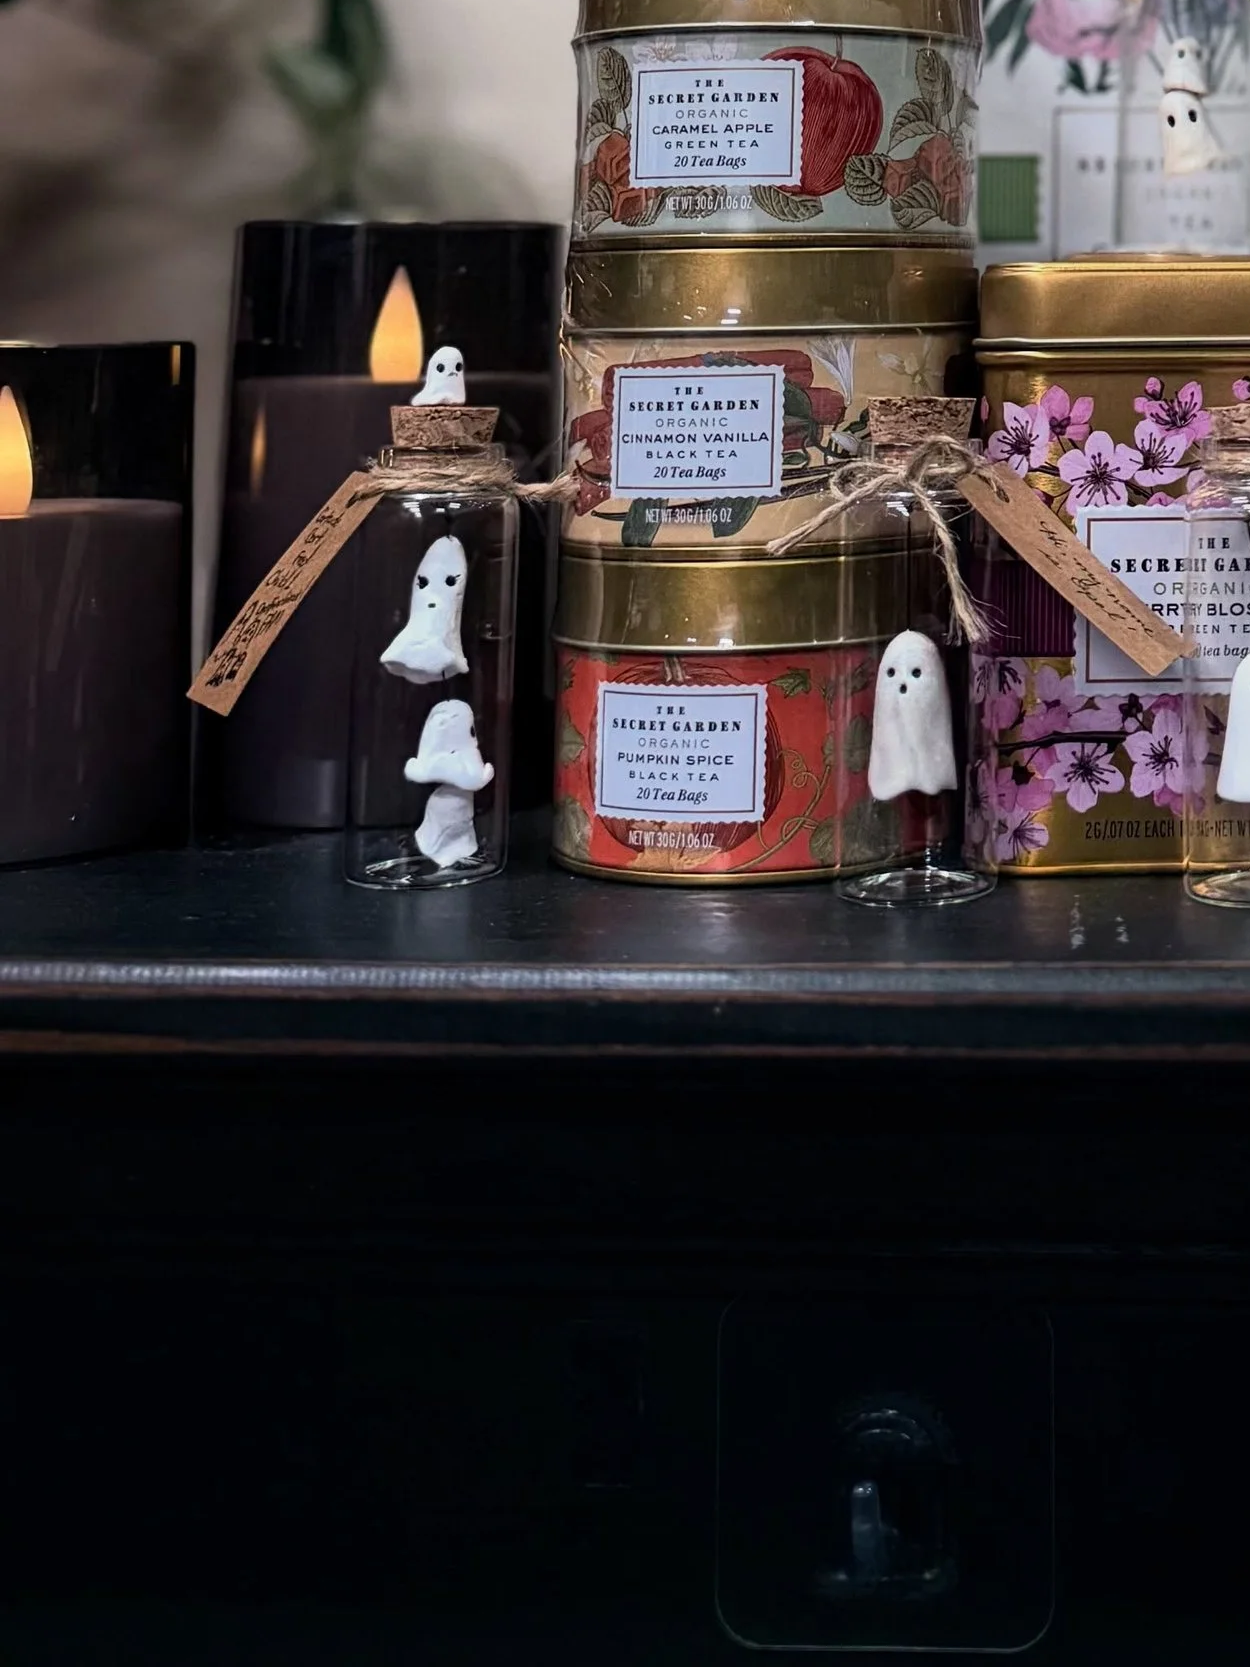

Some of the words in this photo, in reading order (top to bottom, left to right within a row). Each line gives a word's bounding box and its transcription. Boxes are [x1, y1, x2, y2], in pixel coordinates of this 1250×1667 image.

[695, 79, 725, 88] THE
[648, 93, 705, 105] SECRET
[711, 92, 779, 104] GARDEN
[675, 108, 749, 119] ORGANIC
[652, 124, 719, 135] CARAMEL
[723, 123, 774, 134] APPLE
[664, 139, 719, 150] GREEN
[727, 139, 760, 149] TEA
[674, 155, 689, 168] 20
[690, 155, 714, 168] Tea
[716, 155, 748, 170] Bags
[665, 196, 681, 211] NET
[681, 196, 693, 211] WT
[740, 194, 753, 210] OZ
[674, 387, 705, 396] THE
[629, 401, 685, 412] SECRET
[691, 399, 760, 411] GARDEN
[655, 417, 729, 428] ORGANIC
[622, 433, 697, 444] CINNAMON
[703, 432, 769, 443] VANILLA
[646, 450, 697, 459] BLACK
[706, 449, 738, 459] TEA
[653, 466, 669, 479] 20
[670, 466, 693, 479] Tea
[696, 466, 727, 481] Bags
[645, 508, 661, 523] NET
[661, 507, 673, 523] WT
[719, 507, 732, 523] OZ
[1198, 537, 1230, 549] THE
[656, 706, 686, 715] THE
[612, 718, 667, 732] SECRET
[672, 720, 742, 732] GARDEN
[638, 737, 711, 749] ORGANIC
[618, 752, 681, 766] PUMPKIN
[685, 755, 735, 766] SPICE
[628, 770, 680, 781] BLACK
[687, 772, 720, 782] TEA
[636, 787, 650, 800] 20
[652, 787, 676, 801] Tea
[677, 789, 709, 805] Bags
[1125, 820, 1140, 838] OZ
[1144, 820, 1174, 838] EACH
[628, 830, 643, 846] NET
[643, 831, 655, 846] WT
[701, 833, 715, 848] OZ
